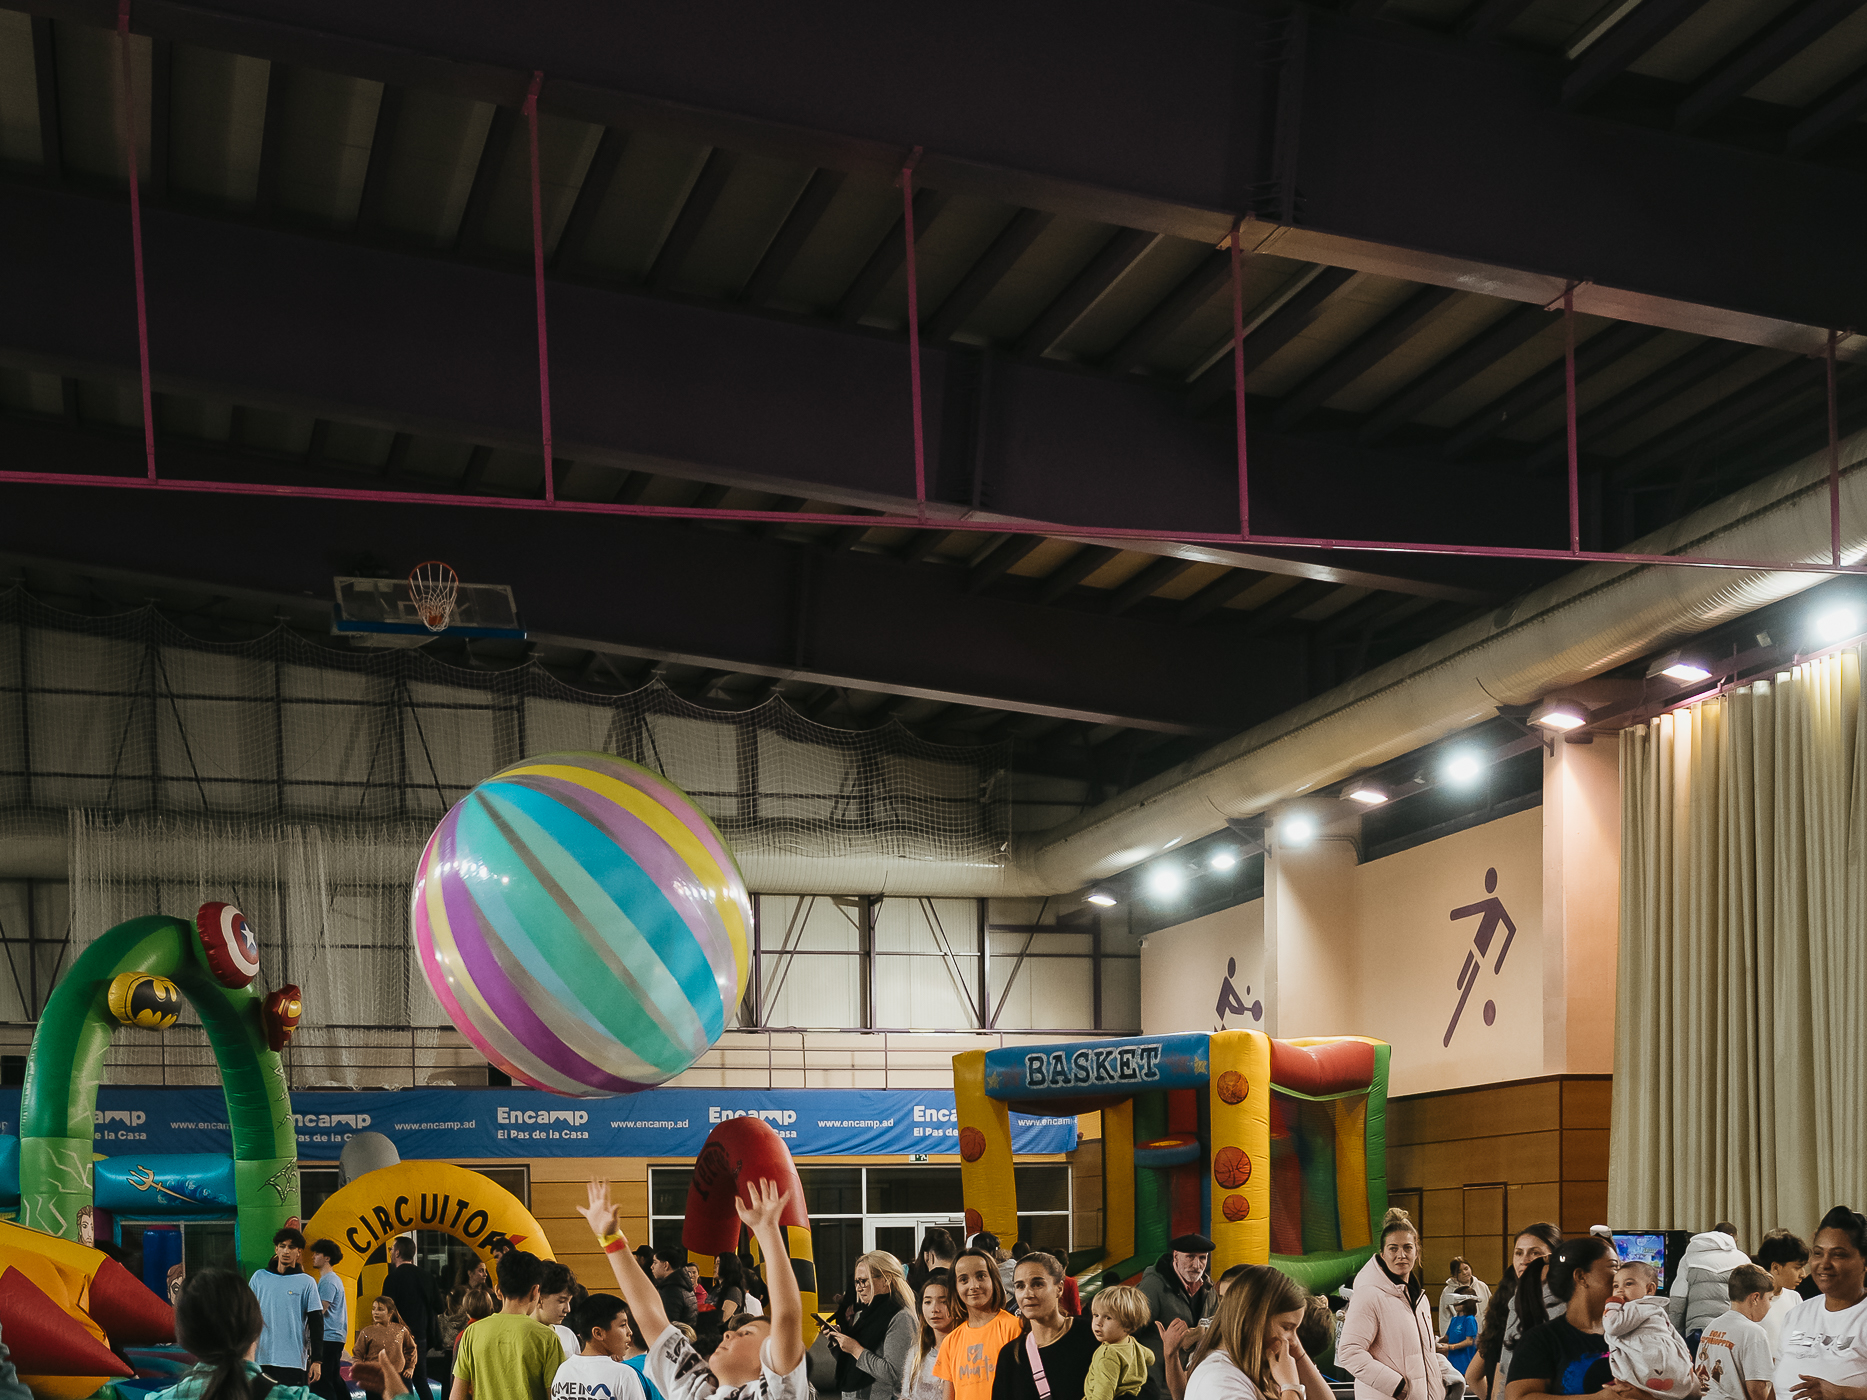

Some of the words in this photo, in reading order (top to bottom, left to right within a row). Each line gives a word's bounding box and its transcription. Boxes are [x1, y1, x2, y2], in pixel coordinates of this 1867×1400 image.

[1026, 1043, 1162, 1089] BASKET
[94, 1110, 146, 1126] amp
[497, 1107, 589, 1126] Encamp
[913, 1105, 957, 1122] Enca
[170, 1121, 233, 1130] www.encam
[292, 1114, 371, 1129] ncamp
[394, 1120, 476, 1131] www.encamp.ad
[610, 1119, 689, 1130] www.encamp.ad
[817, 1118, 894, 1129] www.encamp.ad
[104, 1131, 116, 1140] la
[117, 1131, 147, 1140] Casa
[497, 1130, 508, 1139] El
[510, 1130, 530, 1139] Pas
[532, 1129, 547, 1139] de
[549, 1130, 560, 1139] la
[562, 1130, 589, 1139] Casa
[913, 1127, 923, 1136] El
[925, 1127, 943, 1136] Pas
[296, 1134, 310, 1142] as
[313, 1133, 328, 1142] de
[346, 1193, 489, 1254] CIRCUITO
